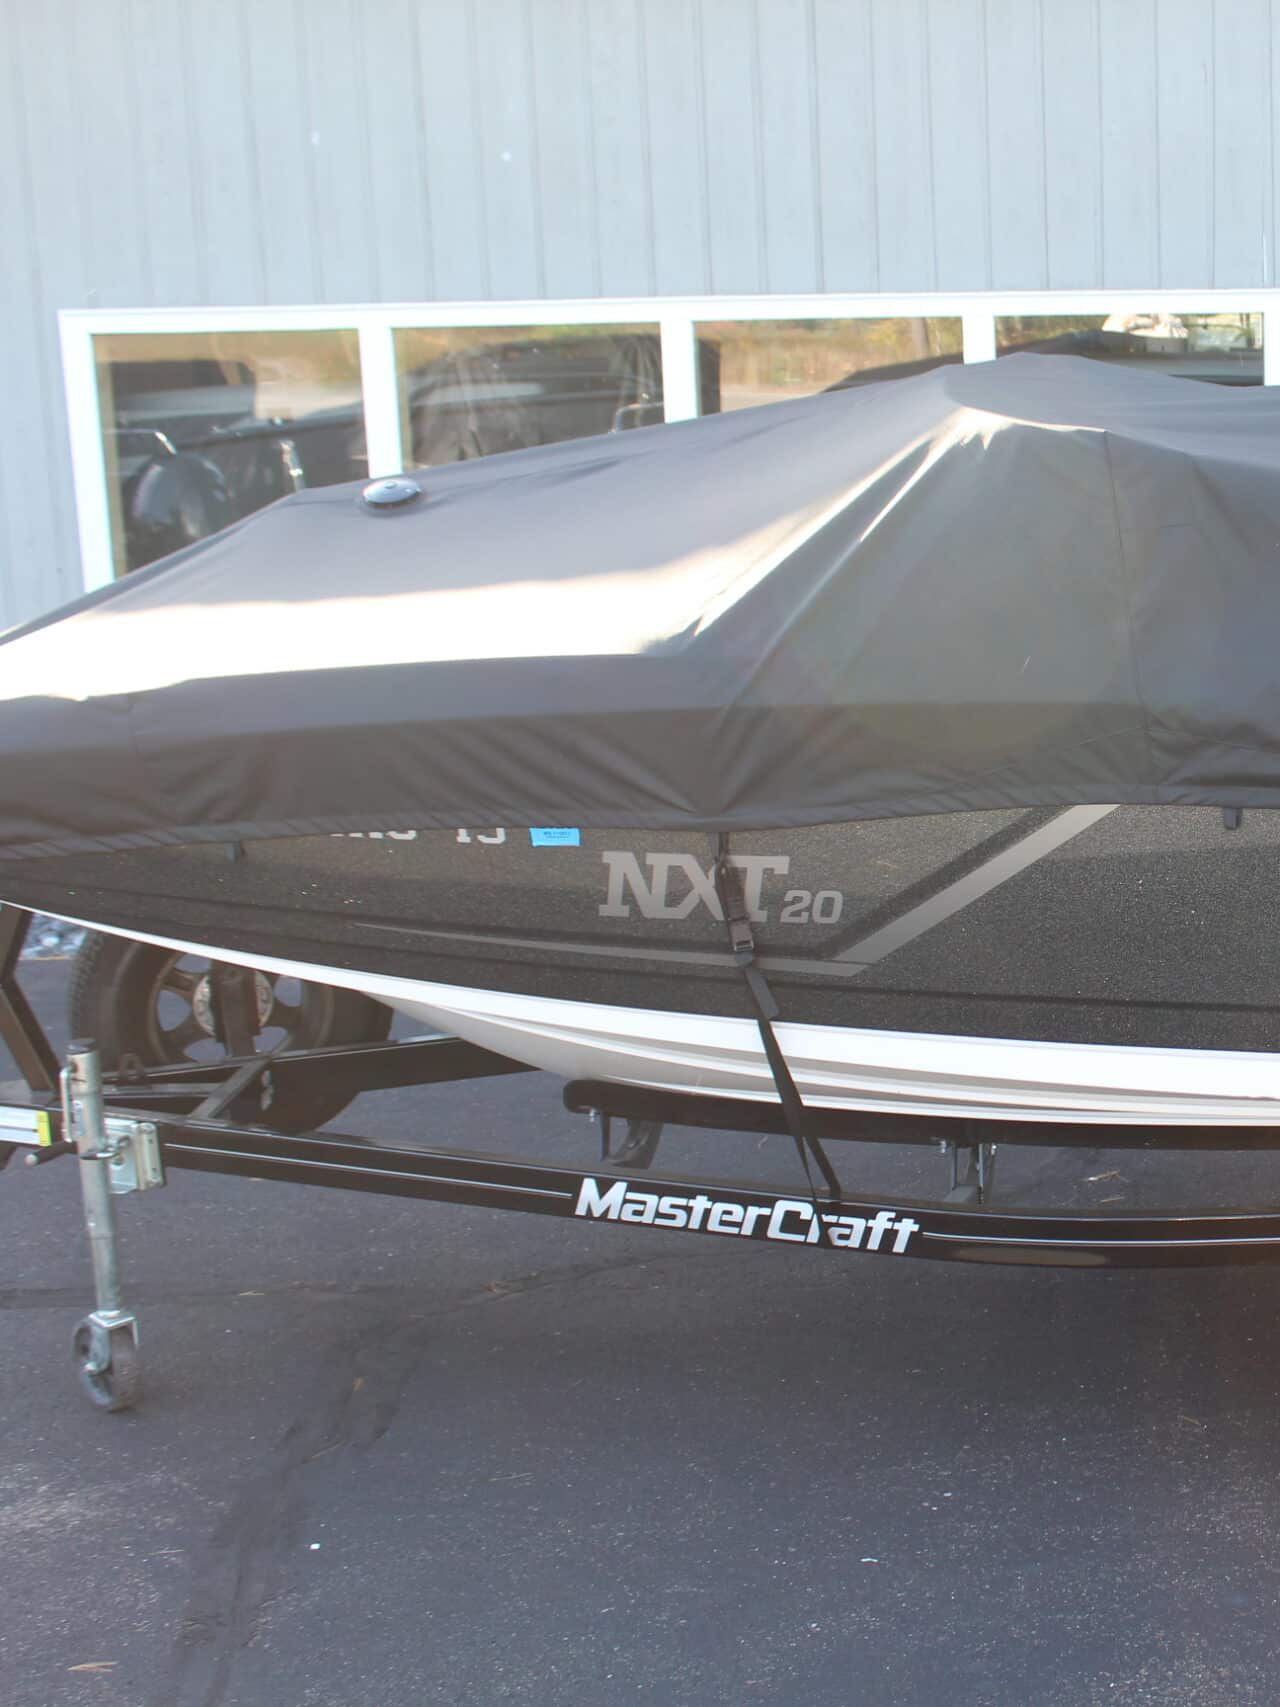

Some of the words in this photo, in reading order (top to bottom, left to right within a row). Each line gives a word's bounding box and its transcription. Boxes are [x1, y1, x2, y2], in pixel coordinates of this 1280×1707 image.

[598, 851, 788, 922] NXT
[780, 889, 843, 924] 20
[574, 1177, 920, 1254] MasterCraft
